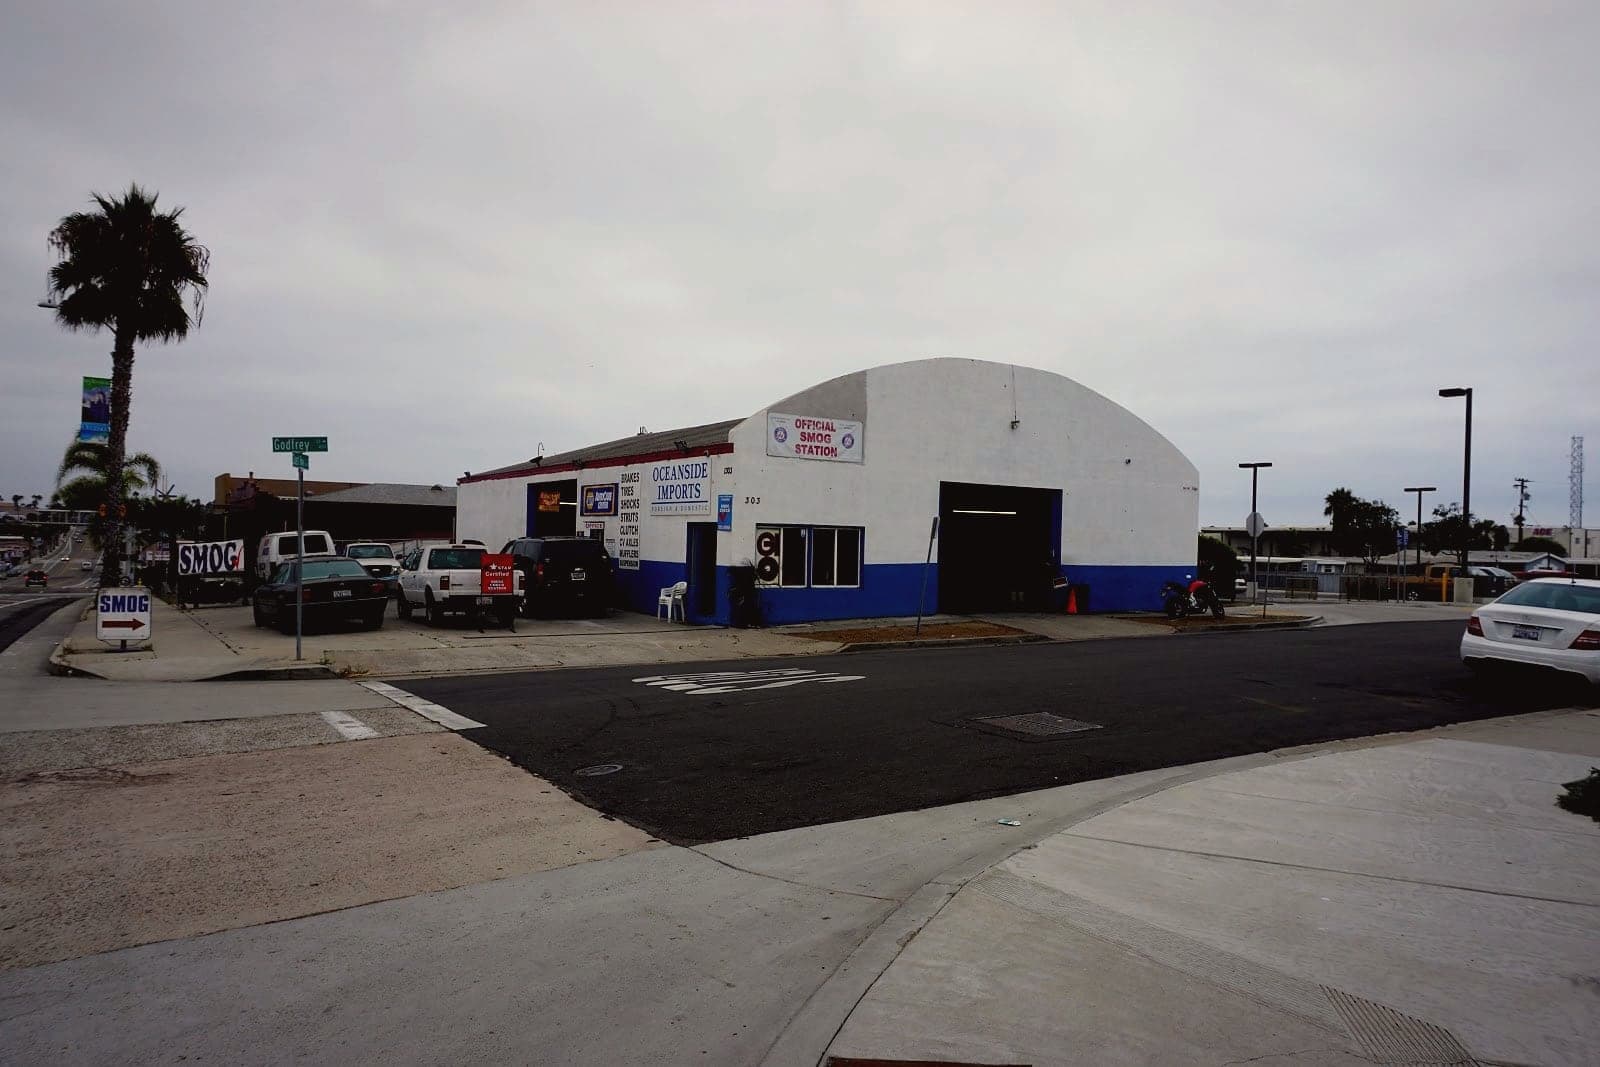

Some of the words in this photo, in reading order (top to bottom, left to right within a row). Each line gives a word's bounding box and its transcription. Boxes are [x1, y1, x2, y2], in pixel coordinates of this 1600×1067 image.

[795, 418, 836, 432] OFFICIAL
[800, 432, 832, 444] SMOG
[274, 439, 310, 451] Godfrey
[795, 444, 837, 457] STATION
[621, 472, 640, 483] BRAKES
[652, 462, 709, 482] OCEANSIDE
[621, 486, 634, 497] TIRES
[657, 483, 702, 500] IMPORTS
[621, 499, 640, 509] SHOCKS
[744, 496, 761, 505] 303
[620, 512, 639, 522] STRUTS
[620, 525, 639, 536] CLUTCH
[180, 542, 237, 574] SMOG
[100, 595, 149, 613] SMOG
